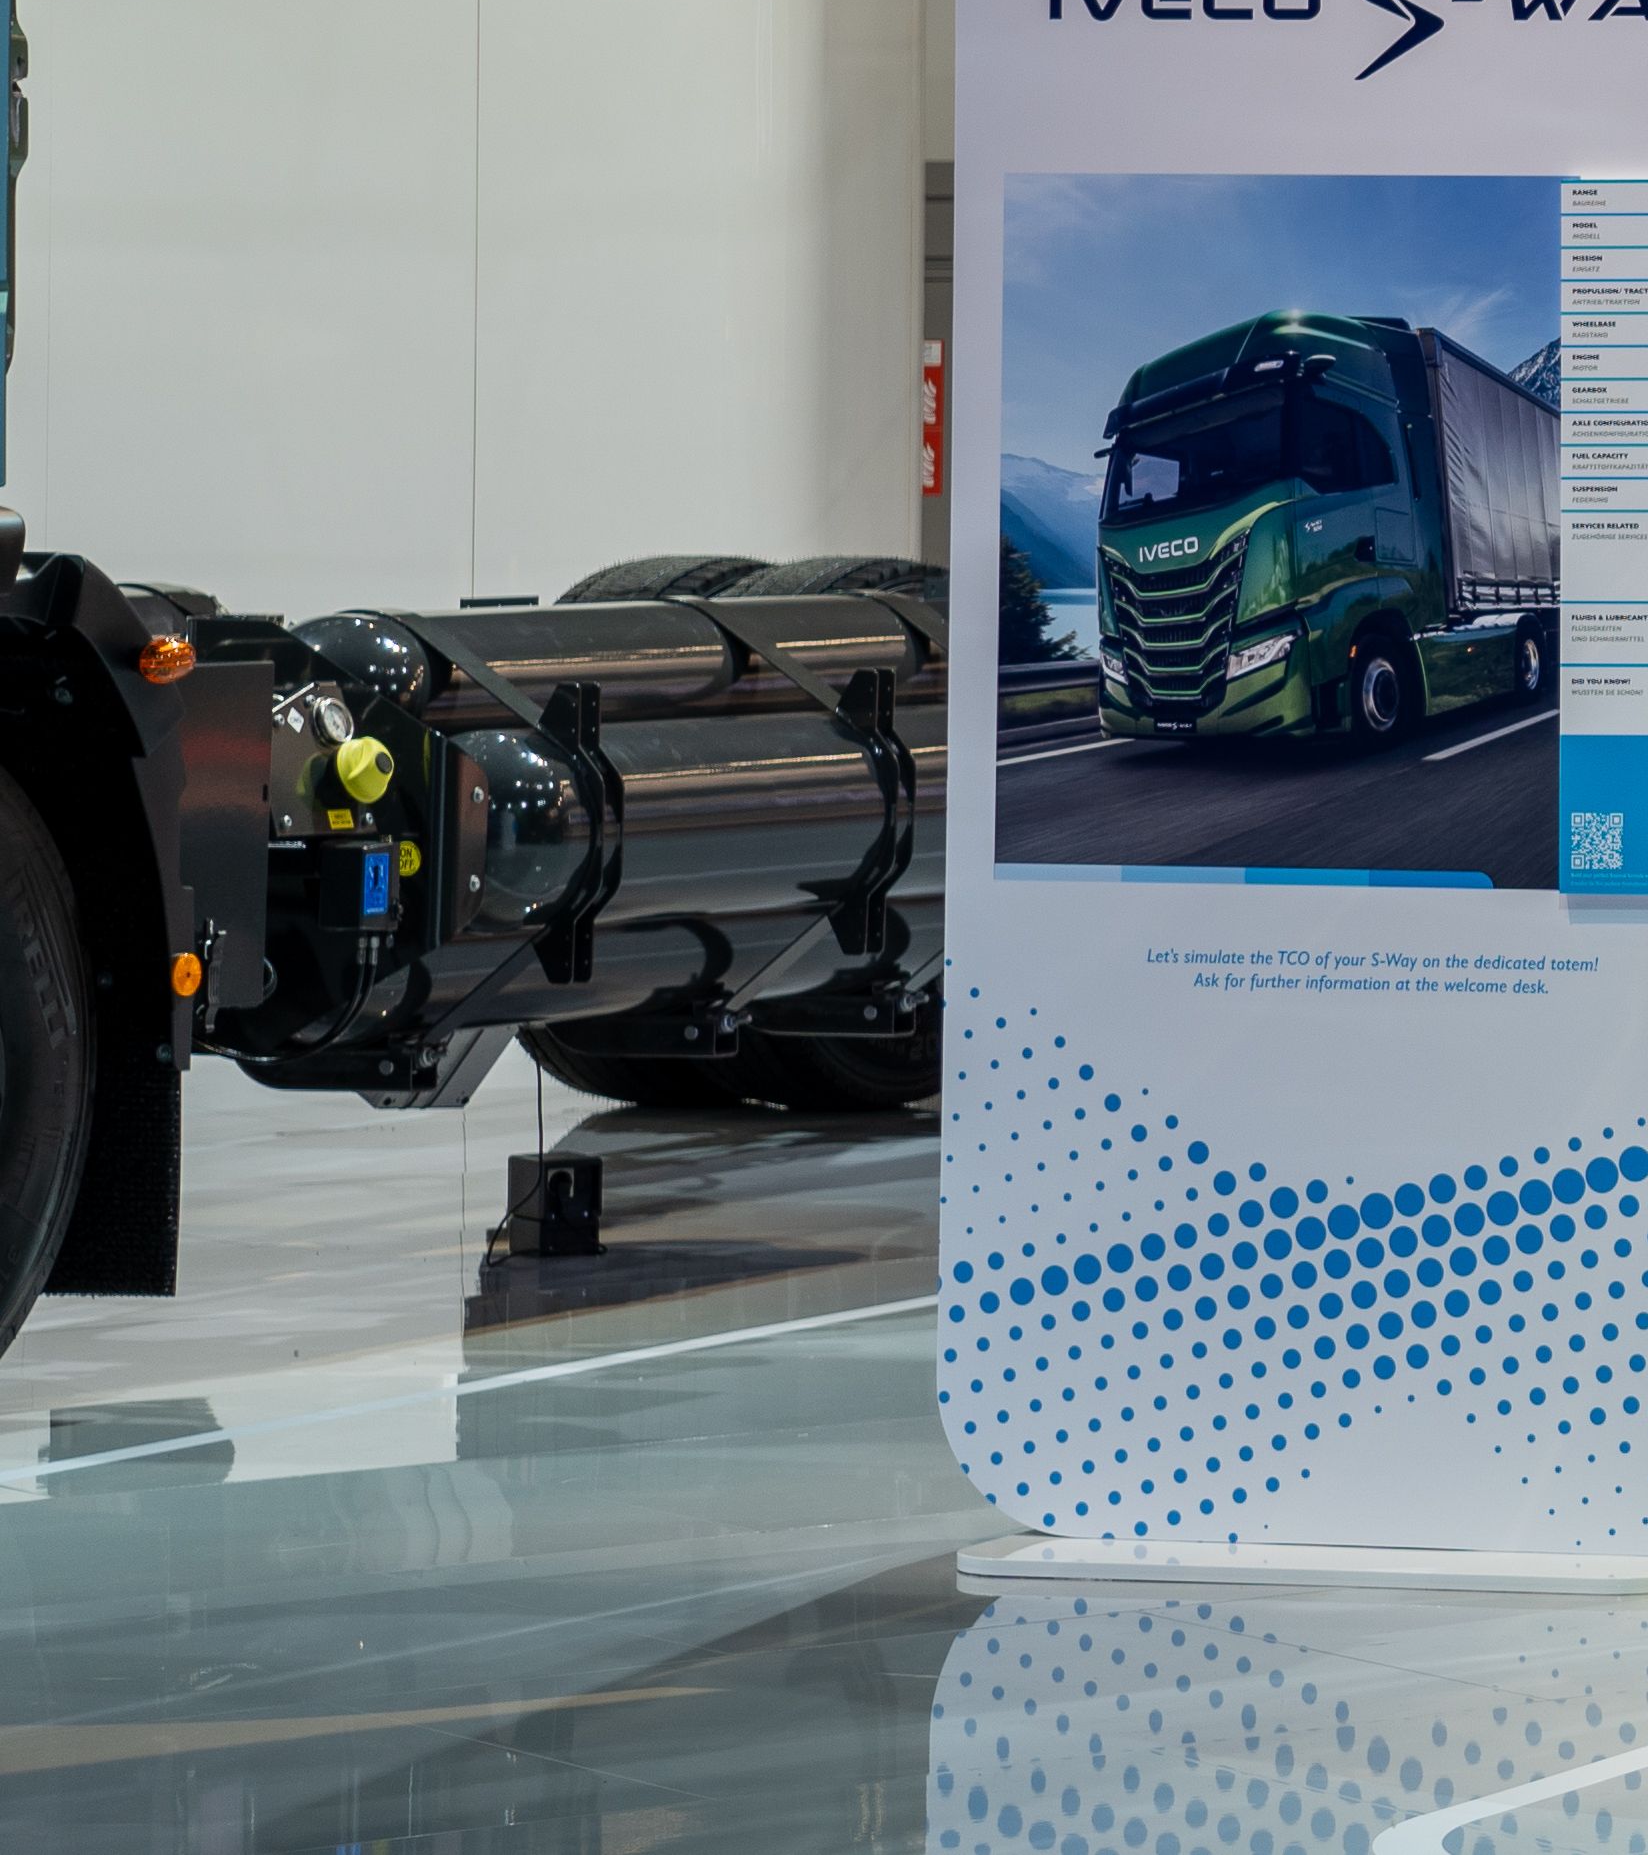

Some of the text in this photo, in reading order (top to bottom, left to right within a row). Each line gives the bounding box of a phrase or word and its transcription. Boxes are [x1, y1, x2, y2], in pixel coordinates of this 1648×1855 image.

[1139, 537, 1199, 563] IVECO
[1147, 948, 1599, 972] Let's simulate the TCO of your S-Way on the dedicated totem!
[1194, 972, 1549, 994] Ask for further information at the welcome desk.
